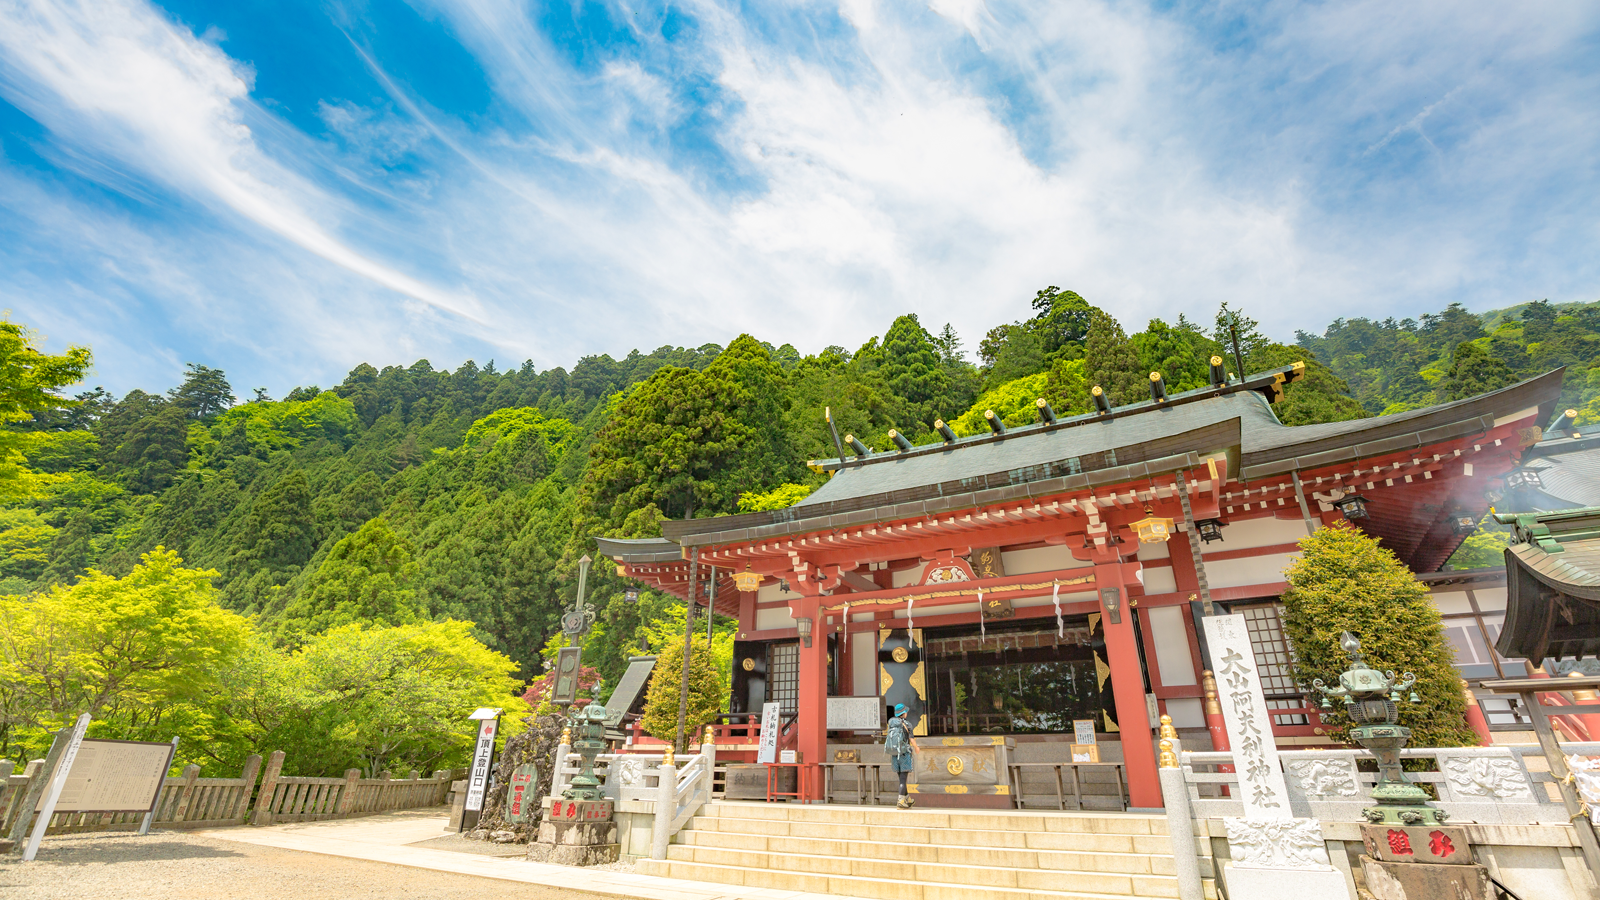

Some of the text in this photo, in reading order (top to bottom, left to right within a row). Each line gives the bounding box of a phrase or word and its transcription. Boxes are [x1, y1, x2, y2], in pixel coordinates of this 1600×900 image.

[767, 705, 778, 747] 古札納札処
[1219, 647, 1280, 809] 大山阿夫利神社
[473, 739, 491, 787] 頂上登山口
